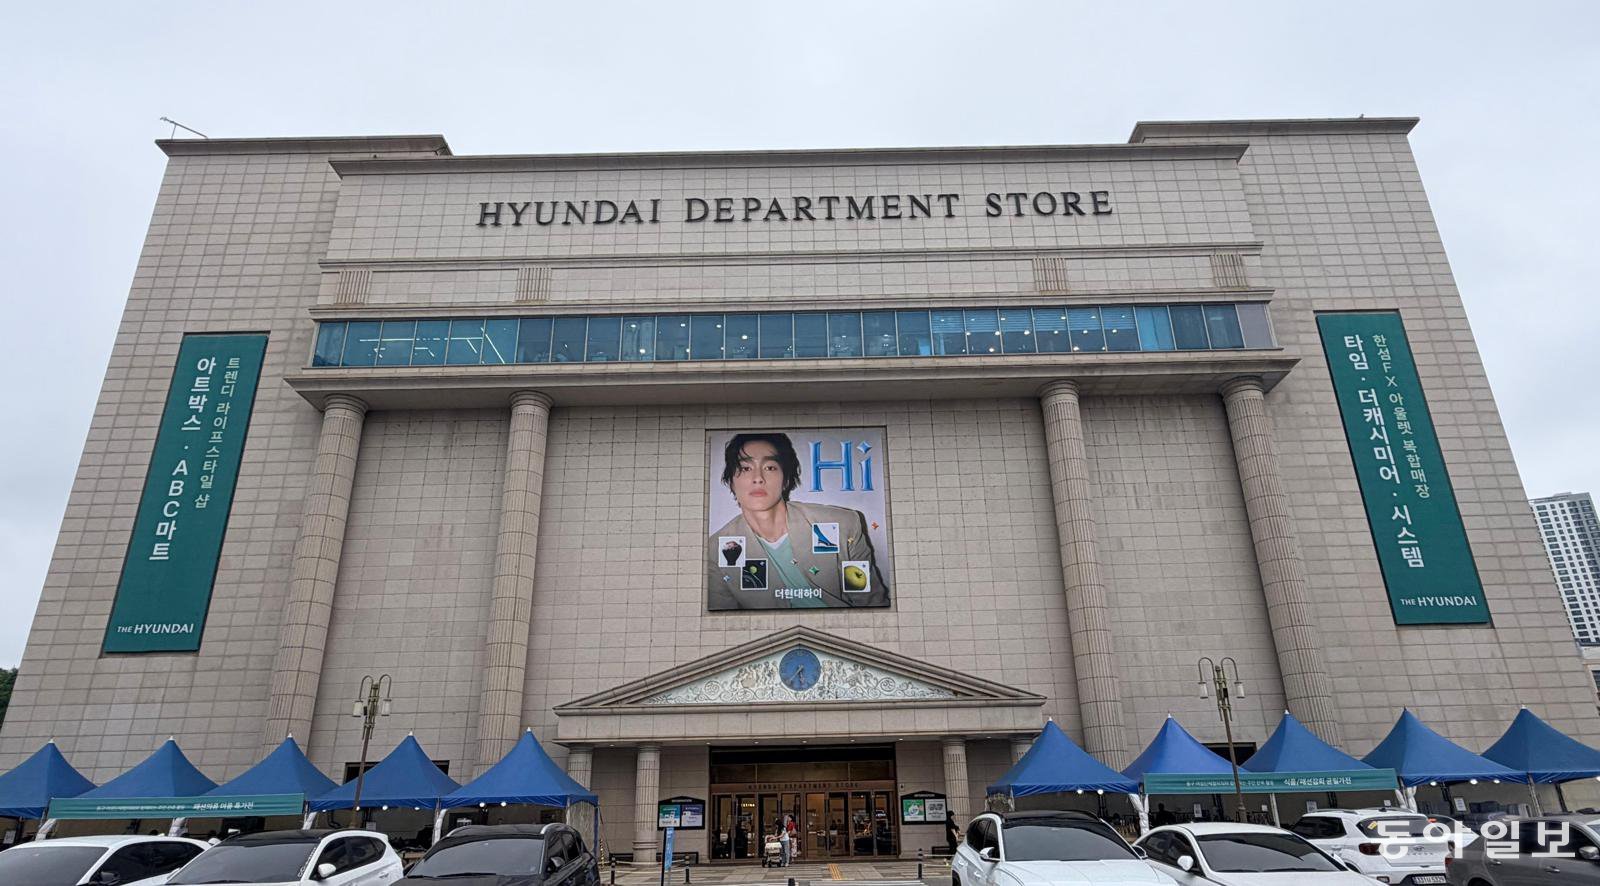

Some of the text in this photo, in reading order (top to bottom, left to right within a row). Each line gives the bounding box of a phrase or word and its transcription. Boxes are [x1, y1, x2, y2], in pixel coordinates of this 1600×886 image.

[475, 190, 1114, 228] HYUNDAI DEPARTMENT STORE
[194, 357, 241, 510] 트렌디 라이프스타일 샵
[1389, 392, 1413, 436] 아울렛
[1402, 439, 1430, 500] 복합매장
[808, 440, 874, 492] Hi
[774, 588, 823, 599] 더현대하이
[1400, 595, 1477, 608] THE HYUNDAI
[117, 623, 194, 635] THE HYUNDAI
